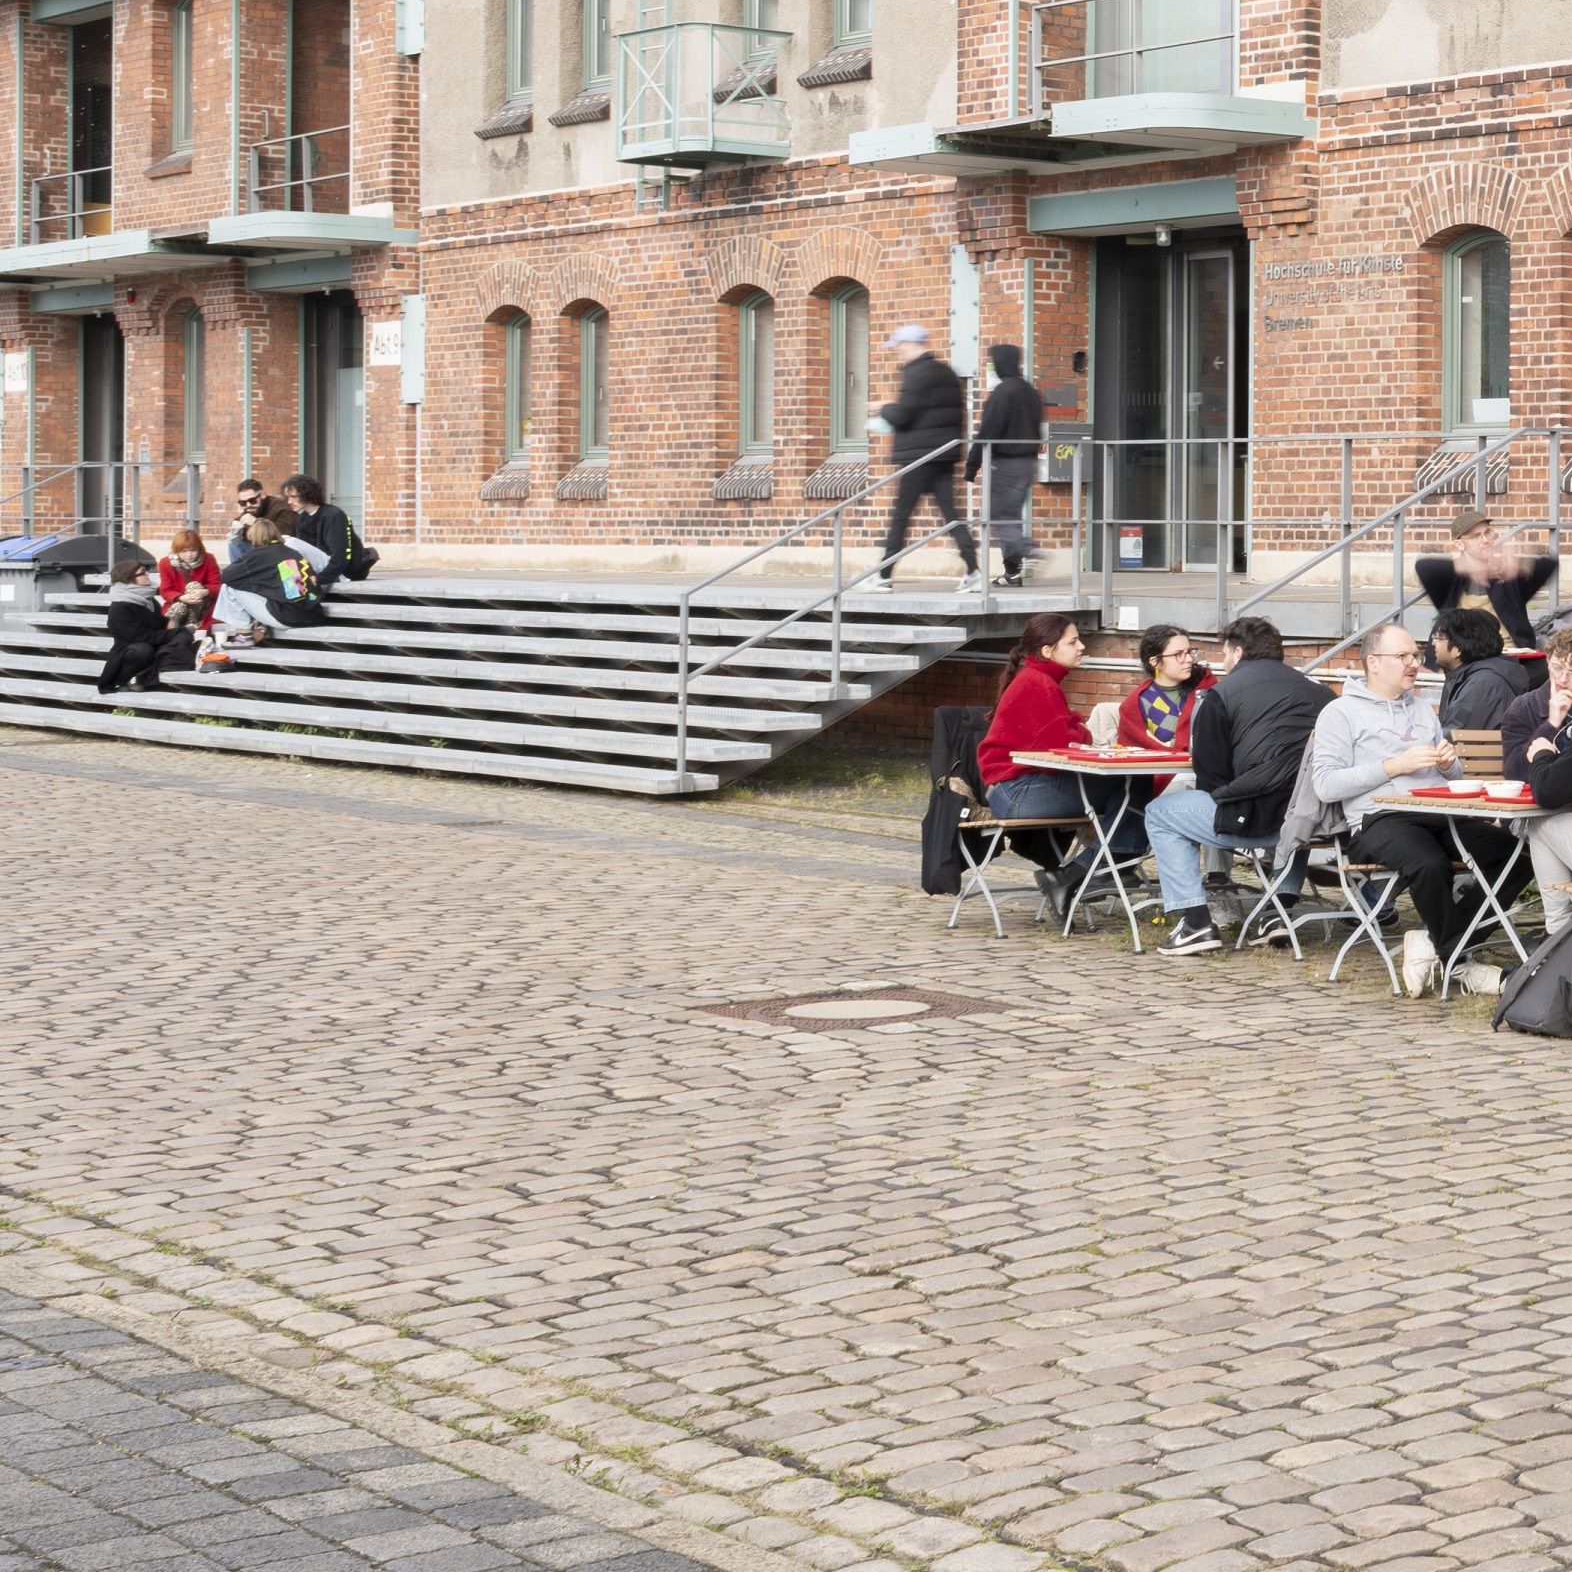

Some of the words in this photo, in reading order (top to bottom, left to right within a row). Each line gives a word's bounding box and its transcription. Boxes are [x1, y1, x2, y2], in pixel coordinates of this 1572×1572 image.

[1265, 259, 1335, 280] Hochschule
[1339, 257, 1357, 275] für
[1360, 255, 1403, 274] Künste
[1265, 286, 1319, 307] University
[1323, 284, 1333, 302] of
[1336, 283, 1354, 302] the
[1358, 283, 1382, 301] Arts
[1264, 315, 1312, 333] Bremen
